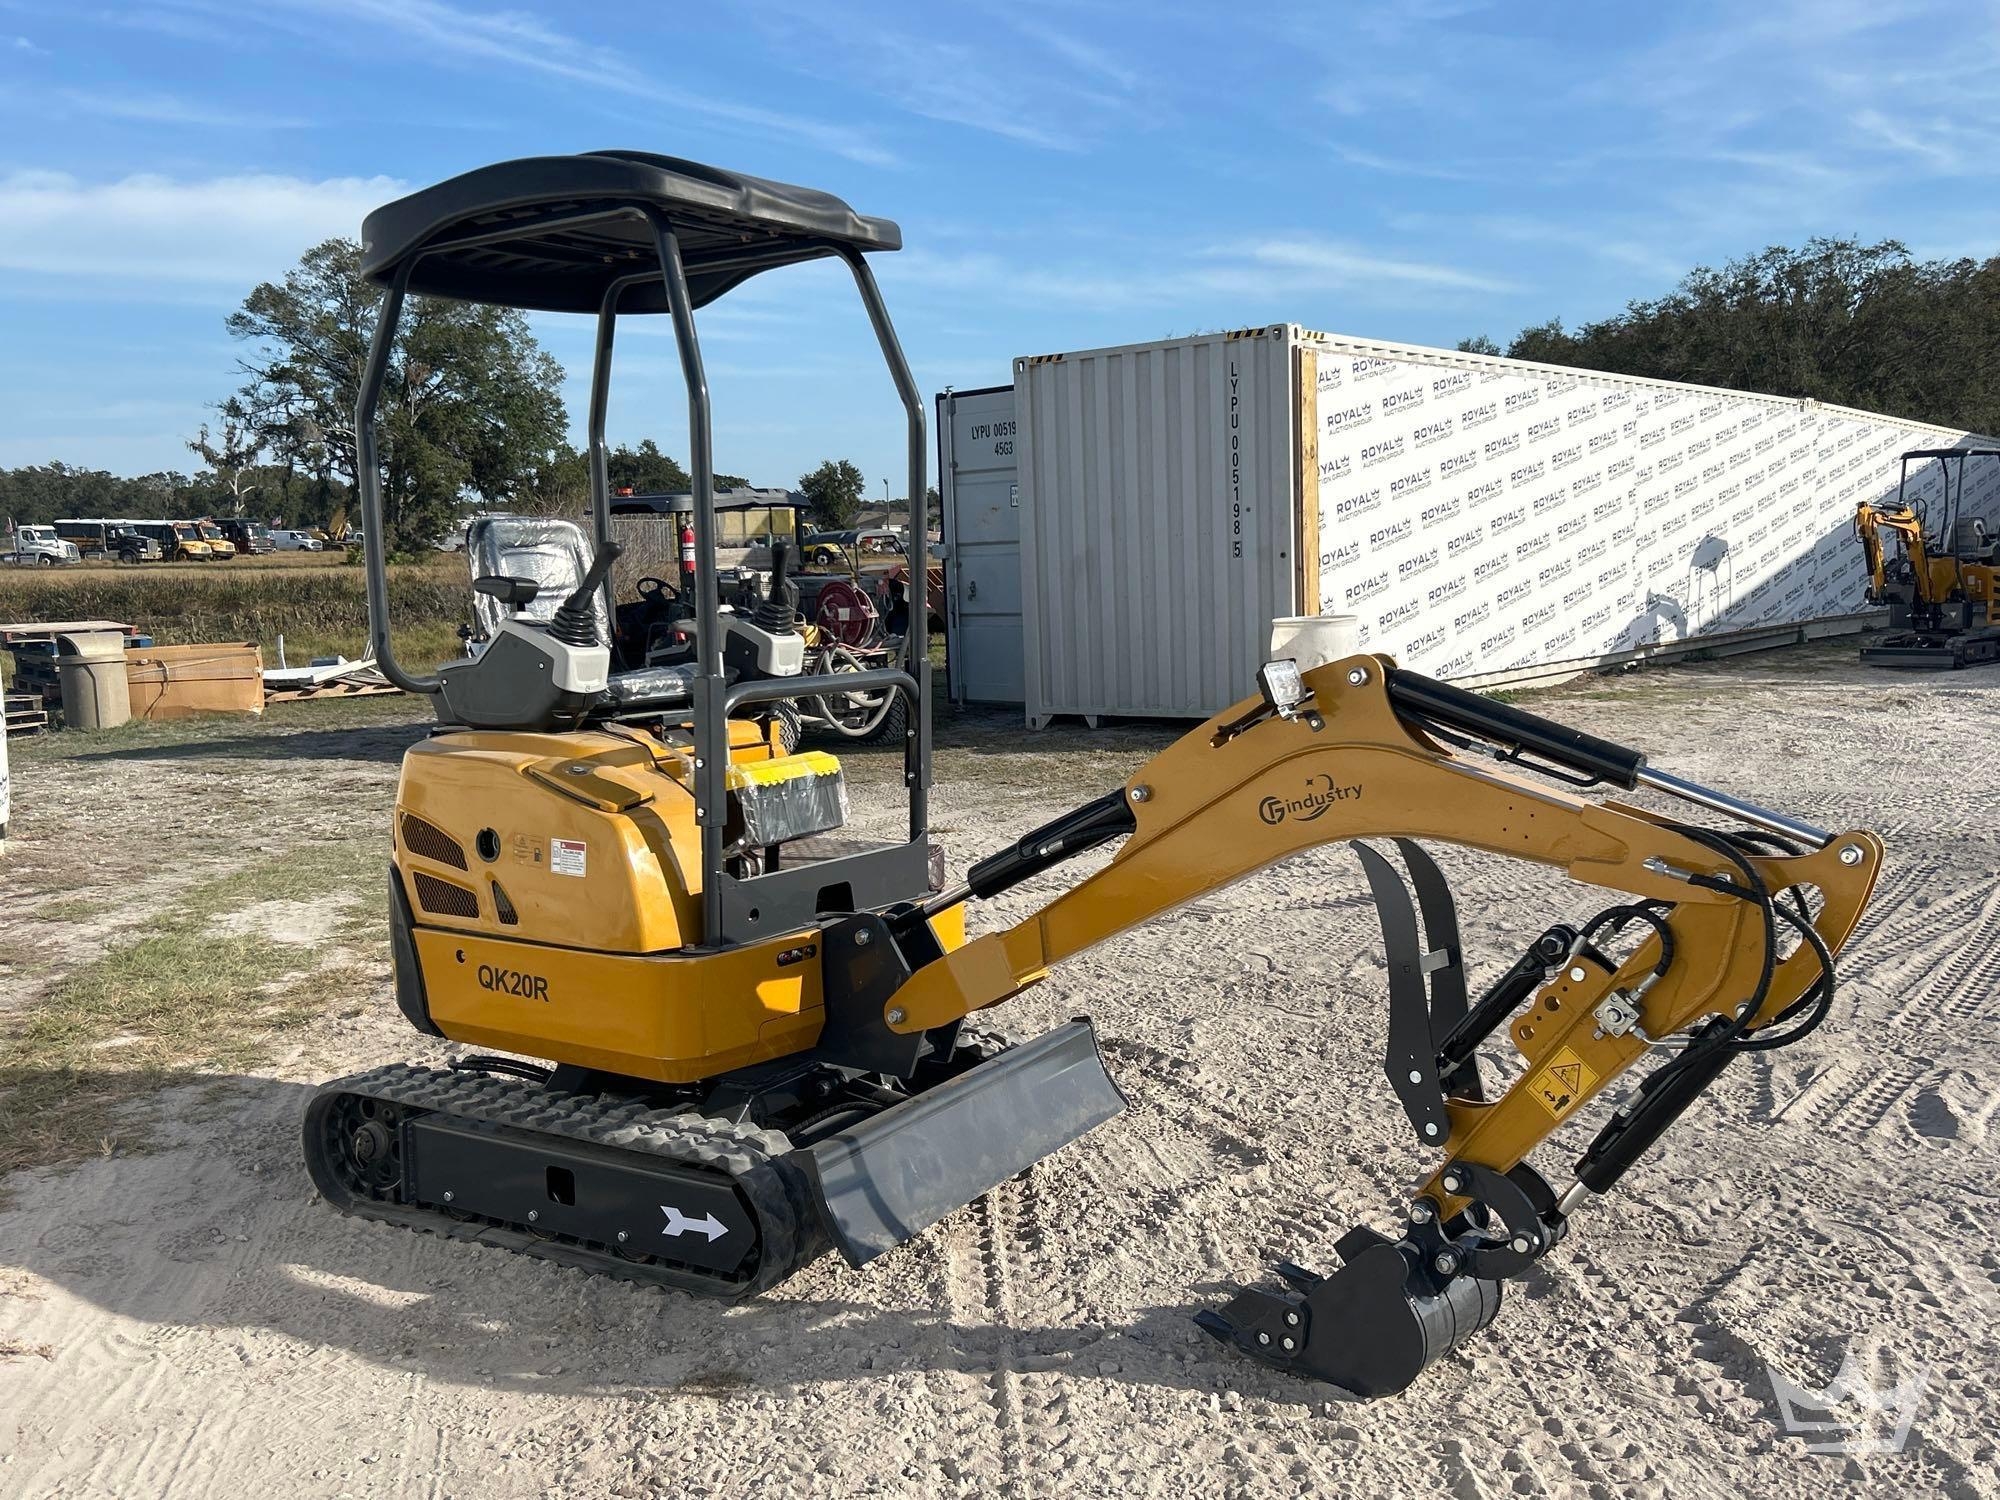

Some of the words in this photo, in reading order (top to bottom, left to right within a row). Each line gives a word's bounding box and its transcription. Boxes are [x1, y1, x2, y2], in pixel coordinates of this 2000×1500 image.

[1432, 374, 1463, 392] ROYAL
[1381, 390, 1415, 409] ROYAL
[1504, 390, 1532, 407] ROYAL
[1326, 406, 1362, 427] ROYAL
[1460, 405, 1490, 423] ROYAL
[1566, 404, 1591, 421] ROYAL
[971, 424, 990, 440] LYPU
[1413, 421, 1445, 440] ROYAL
[1527, 419, 1553, 436] ROYAL
[1360, 440, 1395, 460] ROYAL
[1484, 436, 1512, 454] ROYAL
[1439, 453, 1470, 472] ROYAL
[1551, 447, 1576, 464] ROYAL
[1390, 472, 1423, 492] ROYAL
[1510, 463, 1537, 482] ROYAL
[1466, 482, 1495, 501] ROYAL
[1571, 474, 1595, 491] ROYAL
[1336, 492, 1372, 514] ROYAL
[1533, 491, 1559, 510] ROYAL
[1421, 501, 1452, 522] ROYAL
[1490, 510, 1518, 529] ROYAL
[1369, 522, 1403, 544] ROYAL
[1557, 517, 1581, 535] ROYAL
[1446, 530, 1476, 551] ROYAL
[1516, 536, 1543, 555] ROYAL
[1319, 546, 1350, 567] OYAL
[1576, 542, 1600, 560] ROYAL
[1398, 552, 1430, 574] ROYAL
[1473, 557, 1501, 577] ROYAL
[1539, 562, 1564, 581] ROYAL
[1345, 576, 1380, 600] ROYAL
[1428, 579, 1459, 601] ROYAL
[1496, 583, 1524, 604] ROYAL
[1562, 585, 1586, 604] ROYAL
[1378, 604, 1411, 627] ROYAL
[1453, 606, 1482, 628] ROYAL
[1522, 607, 1548, 627] ROYAL
[1406, 631, 1437, 654] ROYAL
[1480, 630, 1508, 652] ROYAL
[1544, 631, 1569, 651] ROYAL
[1435, 655, 1465, 678] ROYAL
[477, 964, 550, 1003] QK20R
